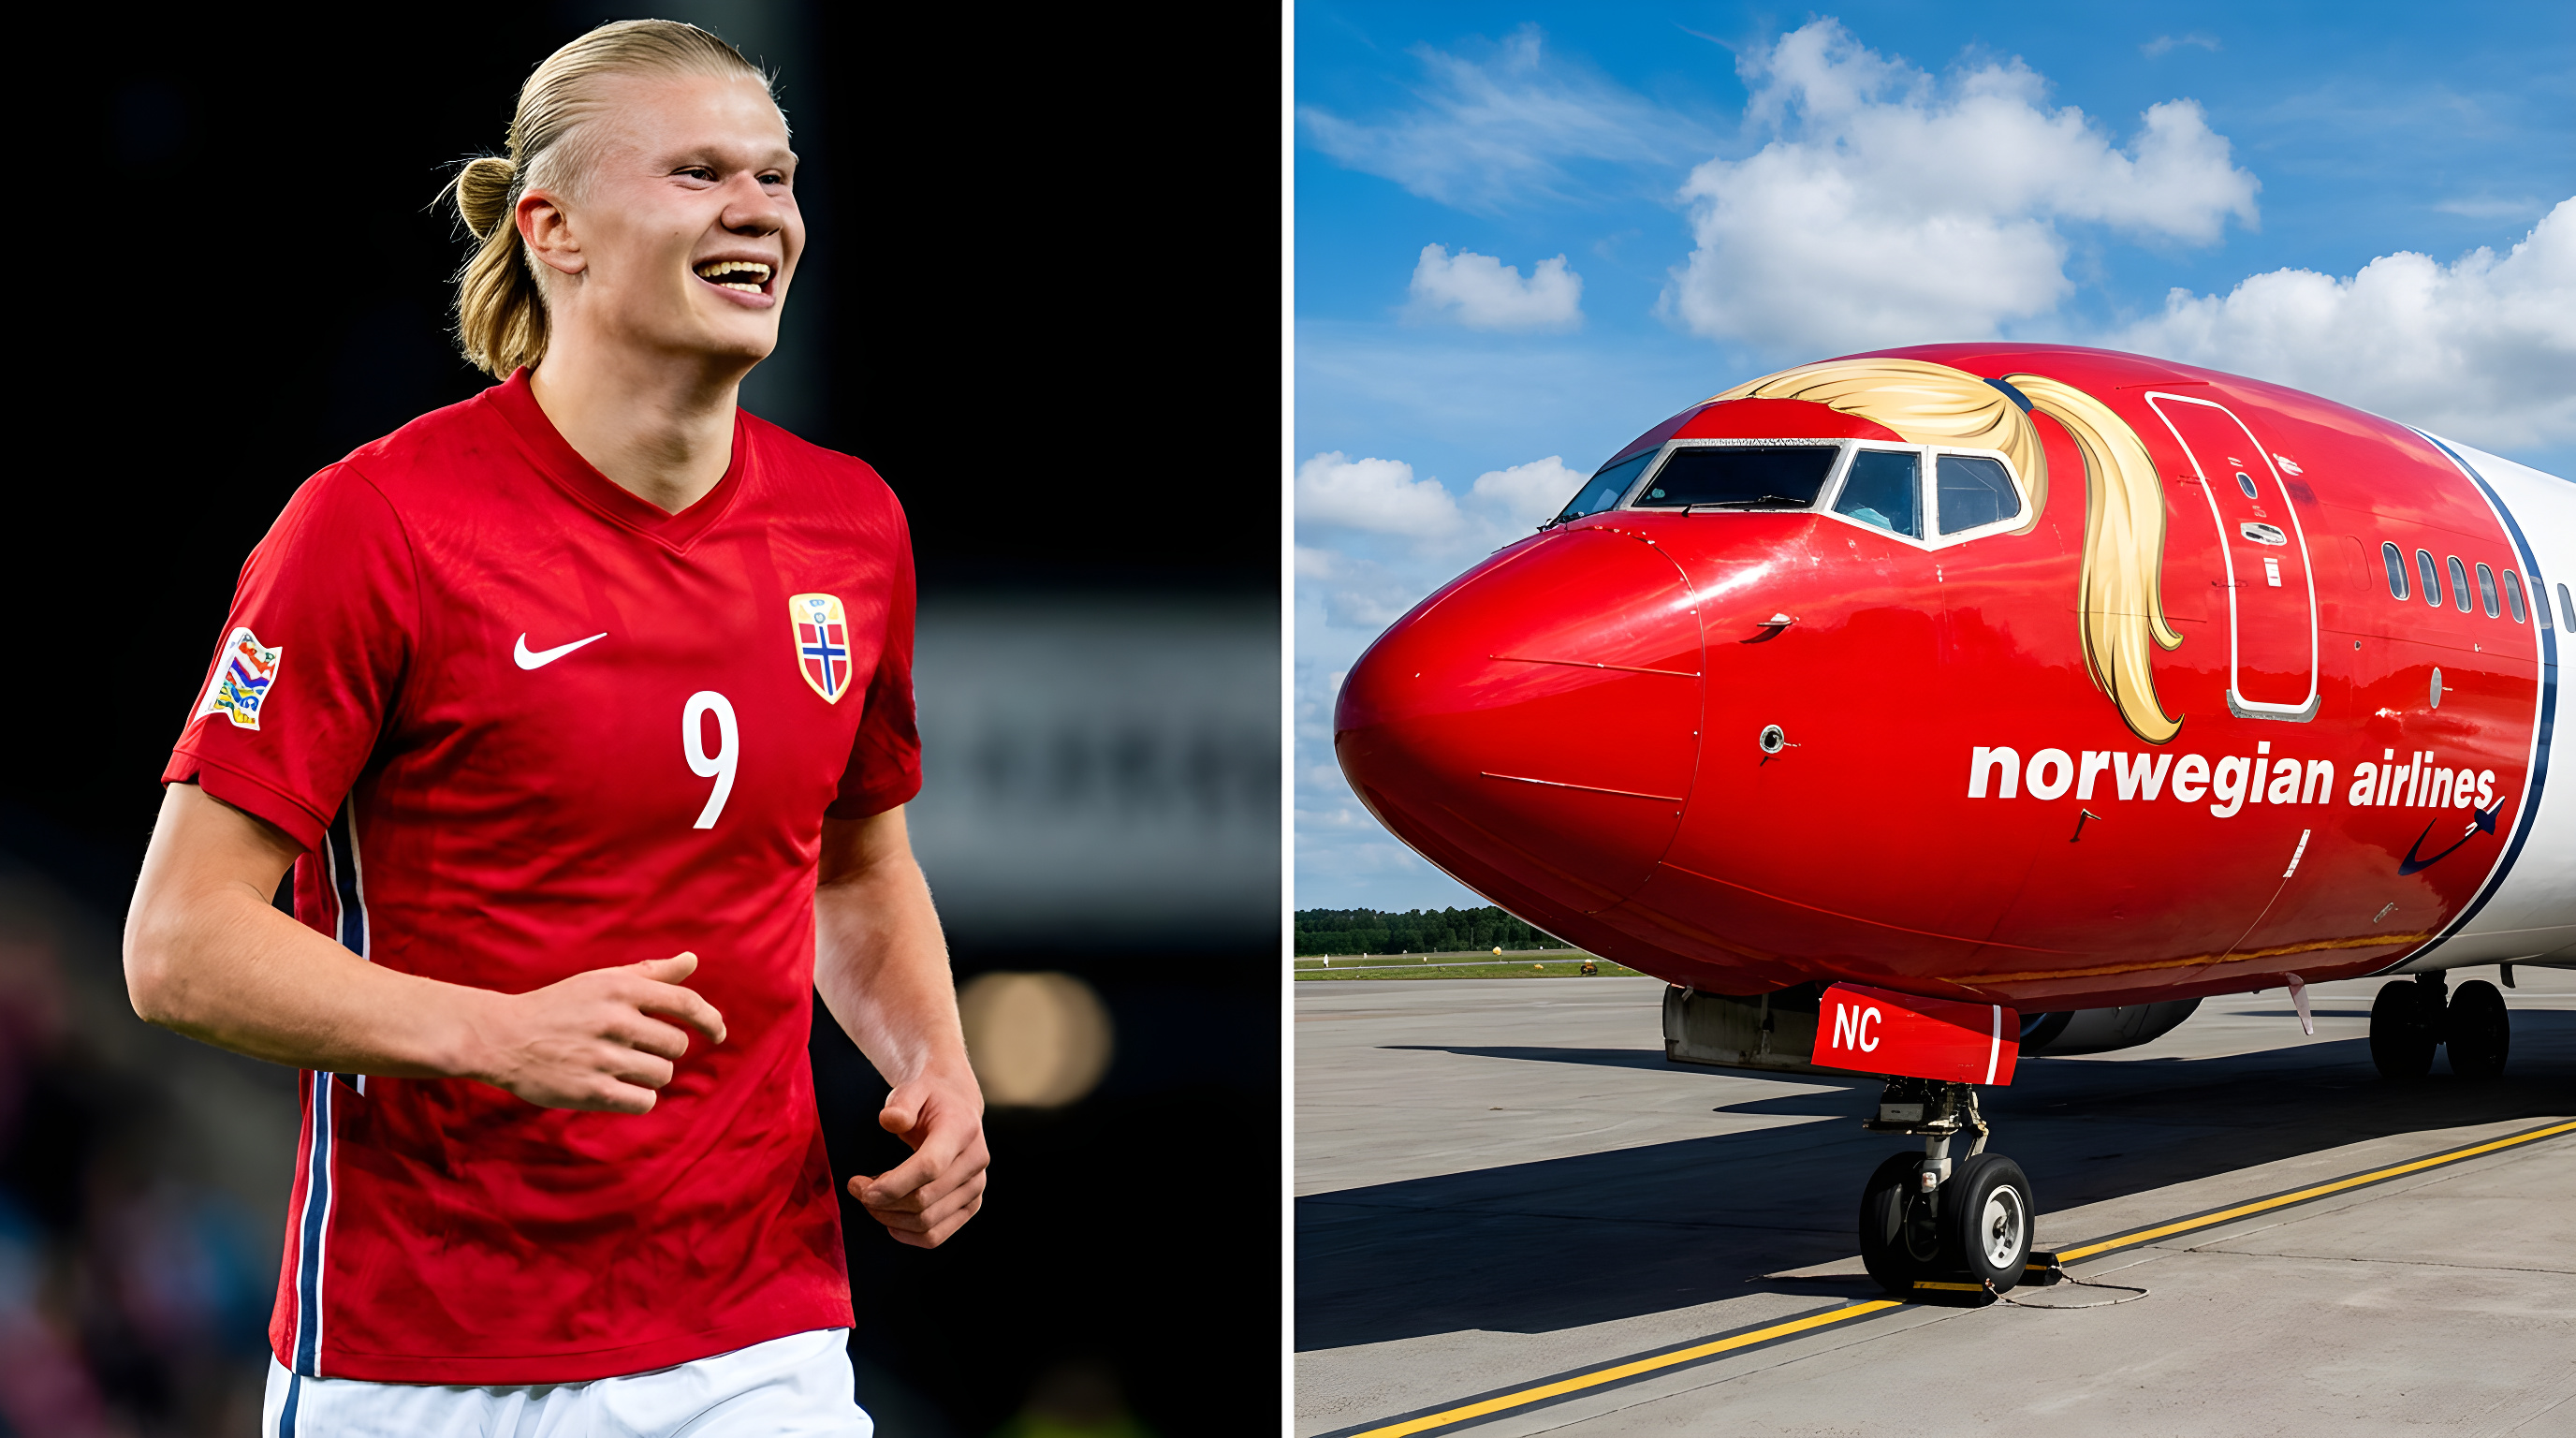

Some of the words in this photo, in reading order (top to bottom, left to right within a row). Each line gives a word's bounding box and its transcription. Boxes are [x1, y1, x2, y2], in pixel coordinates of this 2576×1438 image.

[681, 690, 739, 829] 9
[1967, 741, 2334, 818] norwegian
[2348, 747, 2496, 811] airlines
[1832, 1003, 1881, 1053] NC
